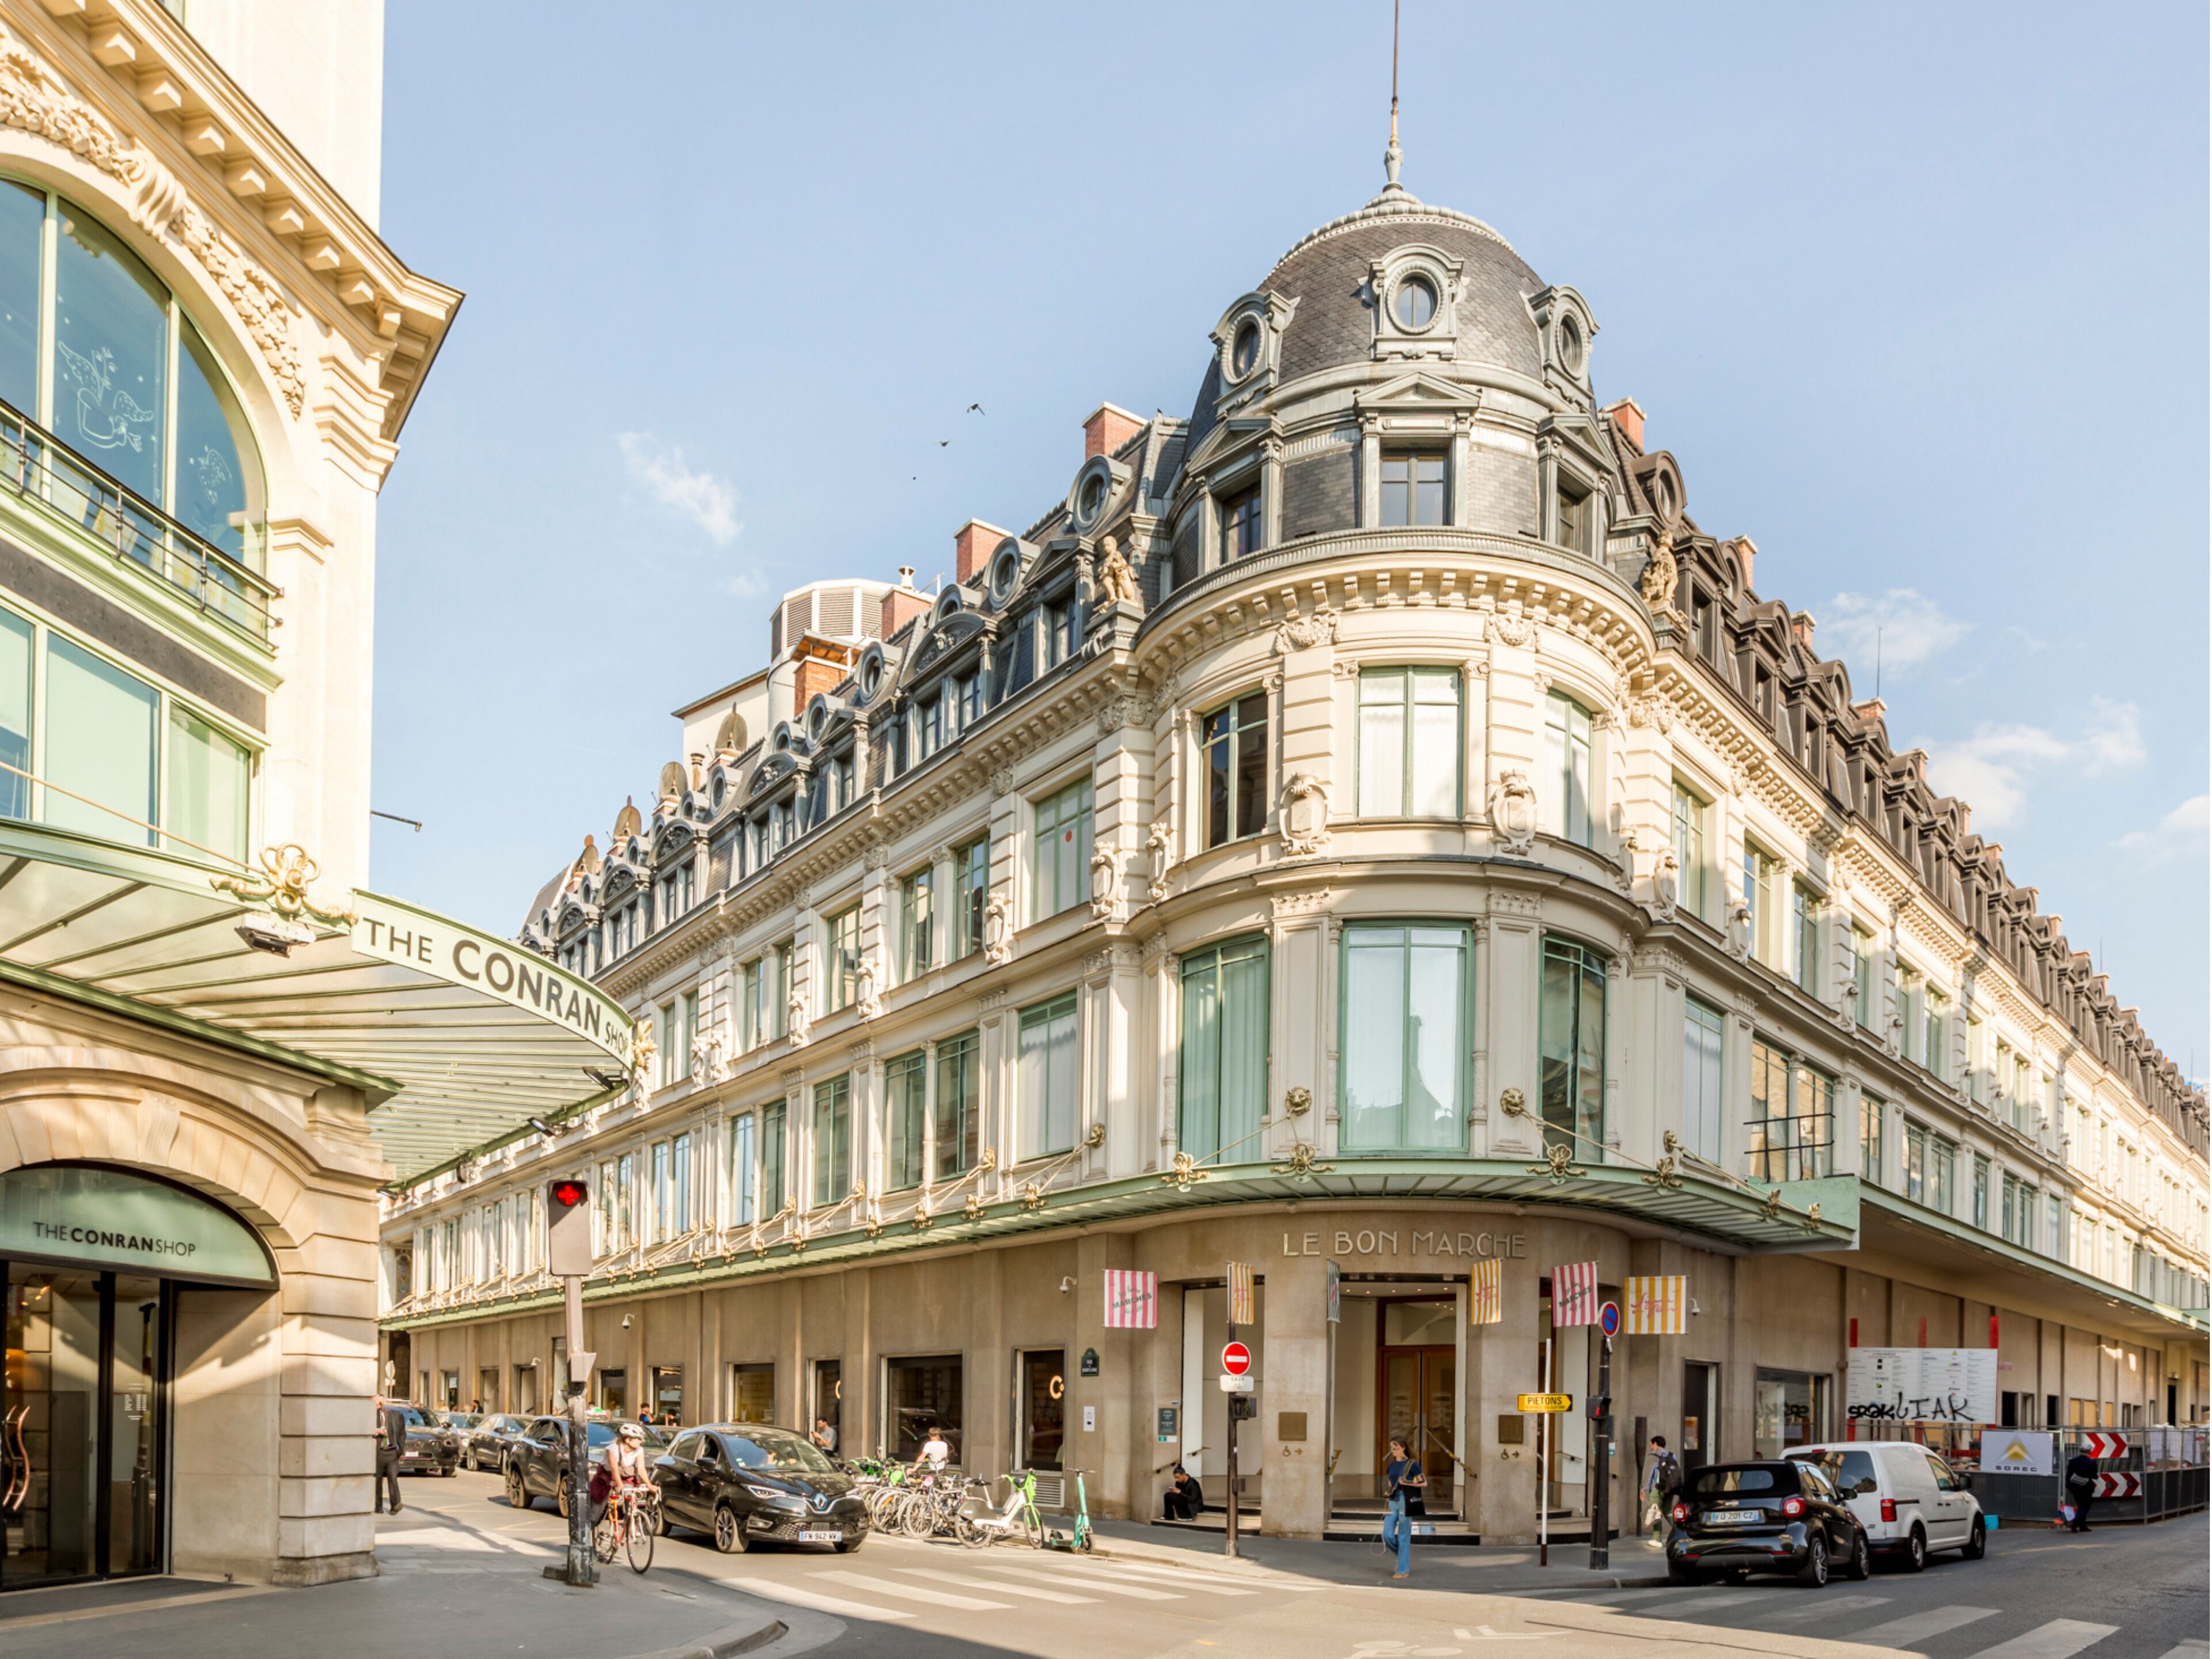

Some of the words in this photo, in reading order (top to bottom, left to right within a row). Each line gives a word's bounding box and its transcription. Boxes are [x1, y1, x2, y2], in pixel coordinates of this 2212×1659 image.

[362, 916, 433, 964] THE
[452, 939, 601, 1038] CONRAN
[605, 1020, 628, 1057] SHOP
[1283, 1232, 1320, 1256] LE
[1334, 1230, 1398, 1255] BON
[1412, 1231, 1527, 1259] MARCHE
[1527, 1396, 1563, 1406] PIETONS
